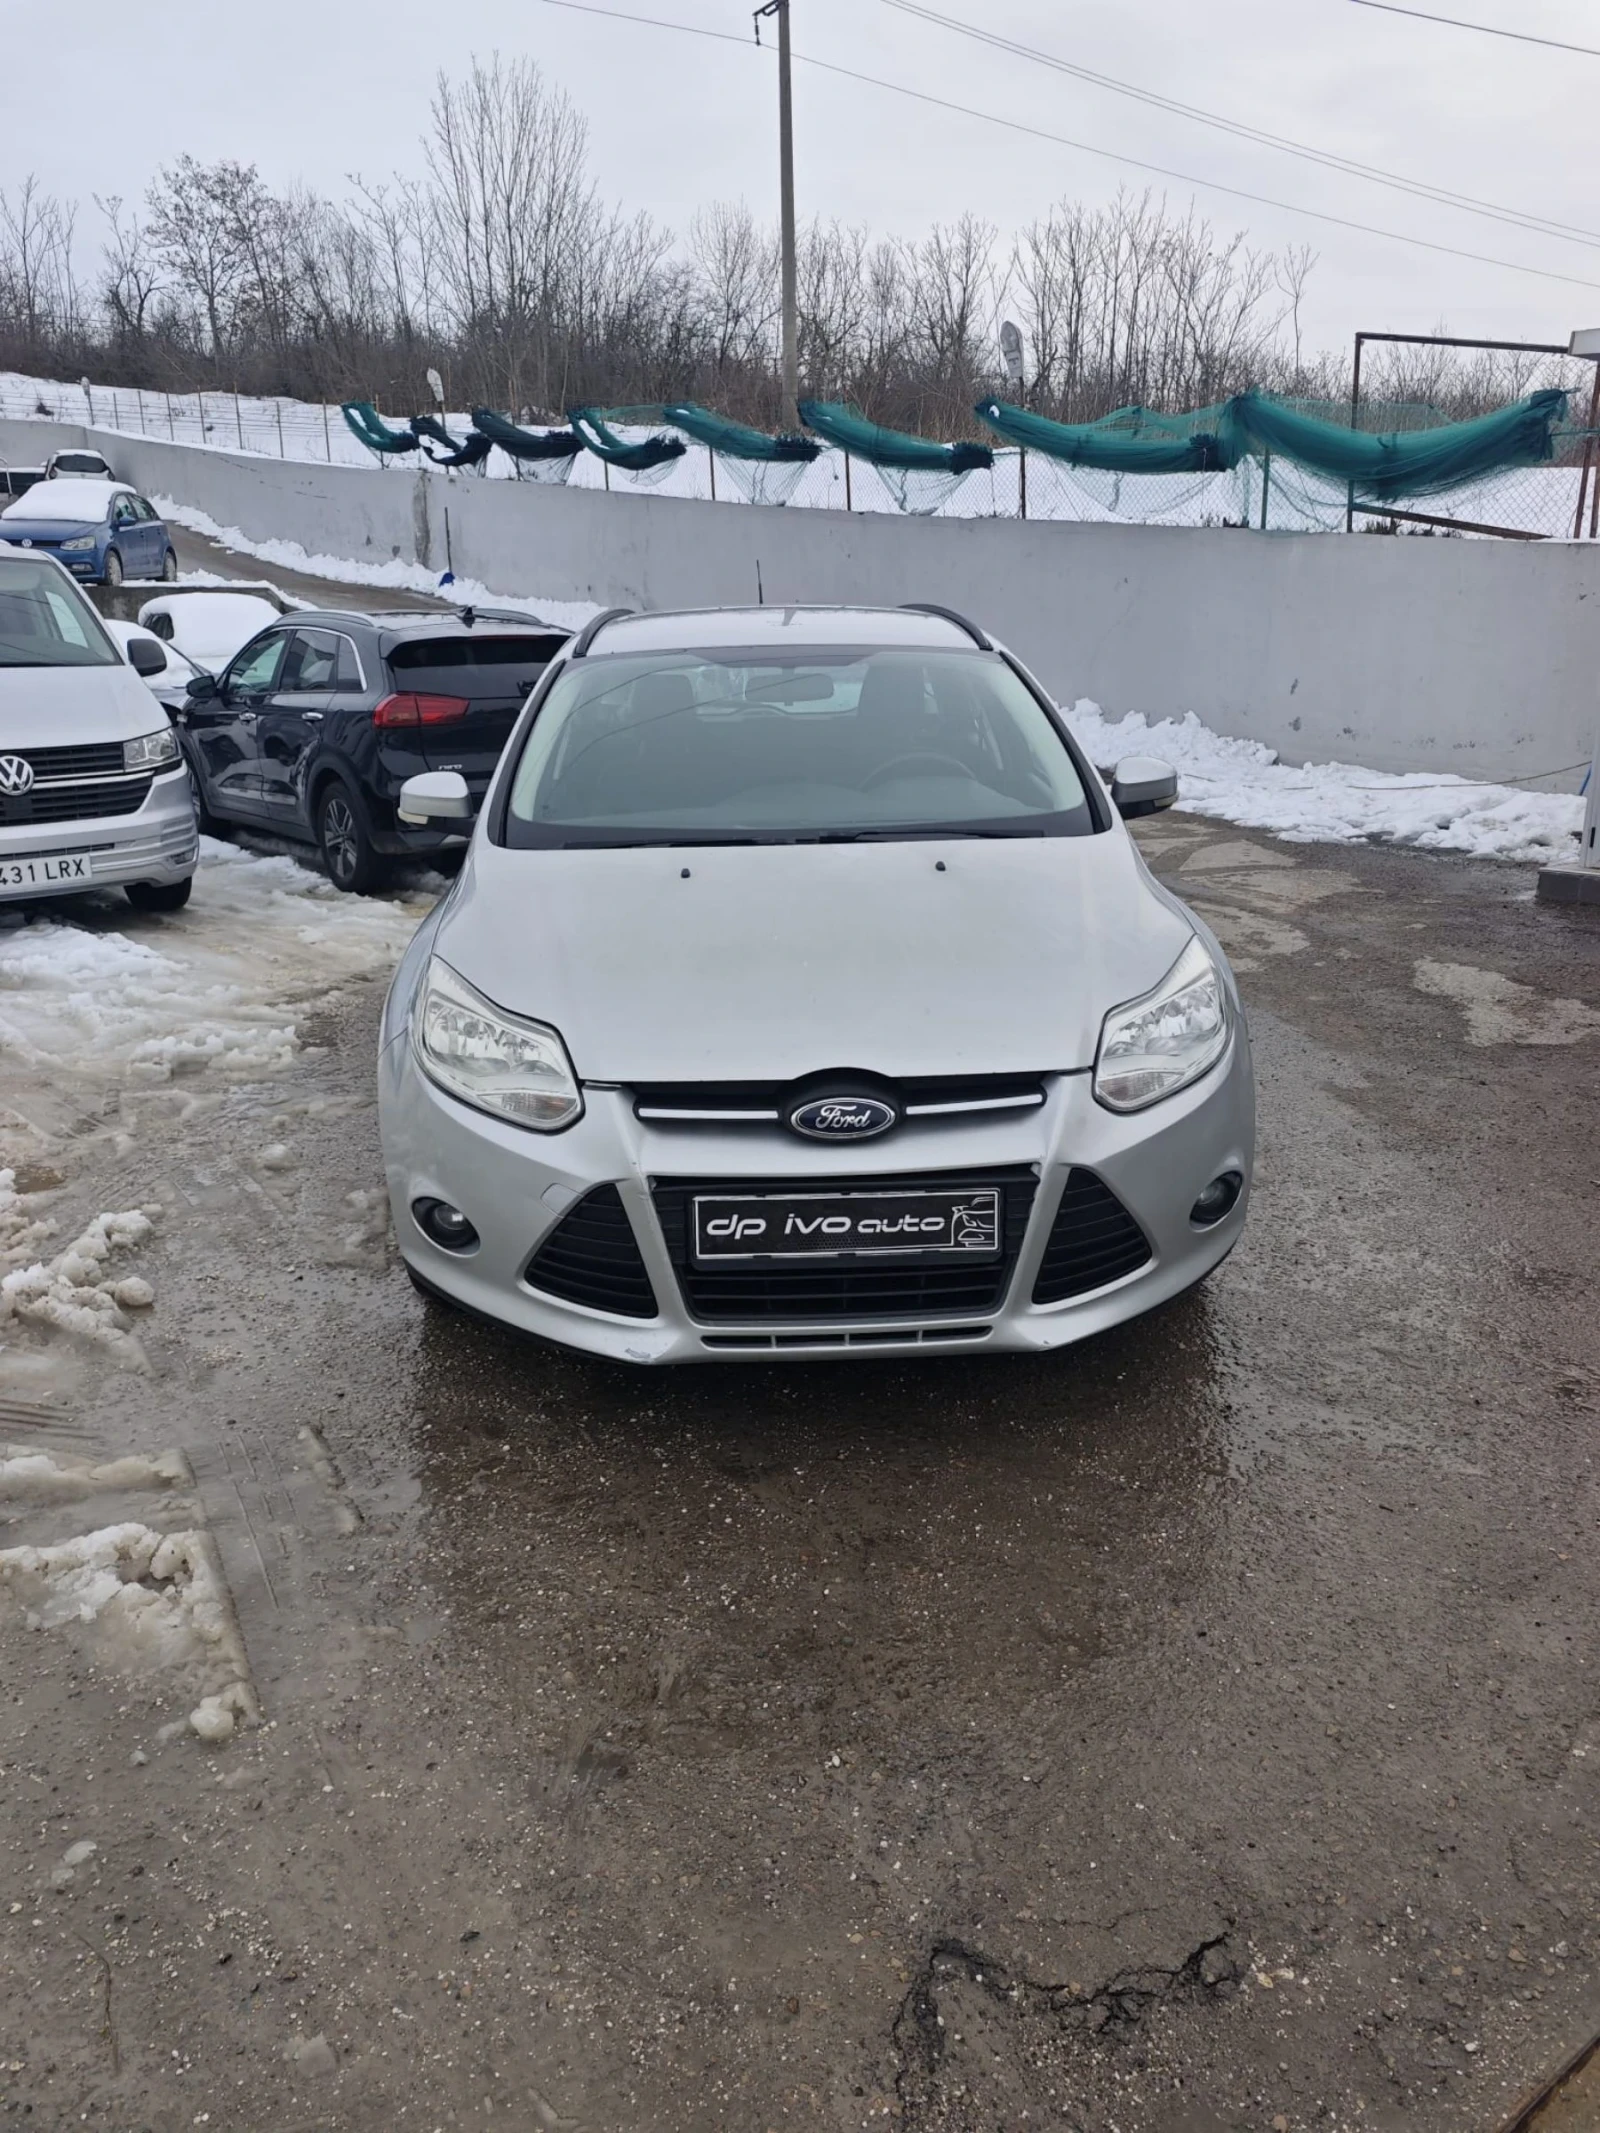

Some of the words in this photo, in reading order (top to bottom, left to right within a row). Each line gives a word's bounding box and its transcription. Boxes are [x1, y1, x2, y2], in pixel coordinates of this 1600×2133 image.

[45, 858, 85, 880] LRX
[815, 1105, 871, 1129] Ford
[784, 1213, 852, 1235] ivo
[857, 1214, 945, 1234] auto
